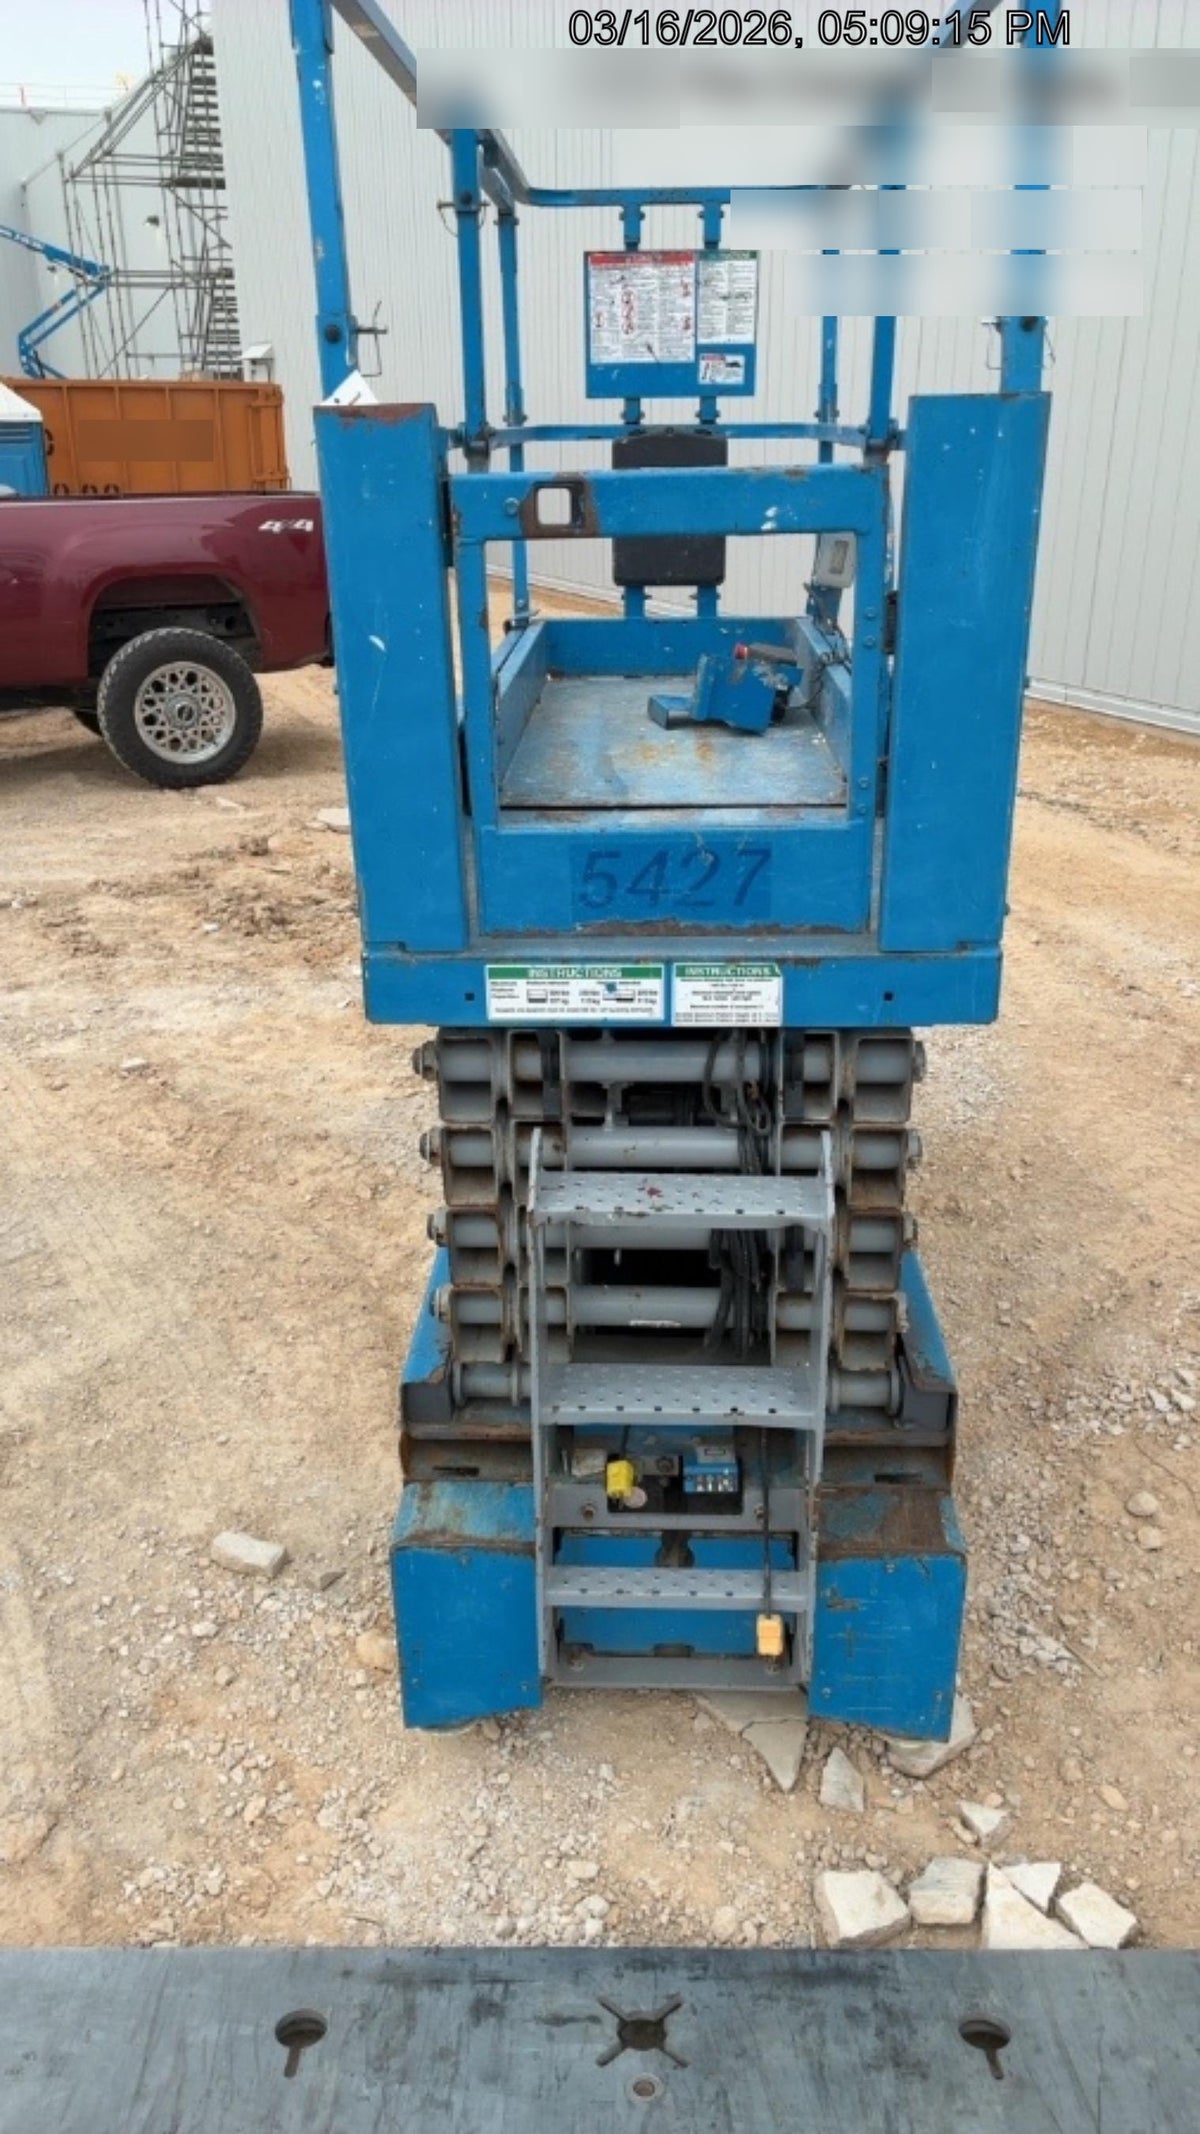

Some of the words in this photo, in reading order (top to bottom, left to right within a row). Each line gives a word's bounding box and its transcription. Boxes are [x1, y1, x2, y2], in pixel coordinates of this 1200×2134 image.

[579, 848, 772, 908] 5427
[528, 967, 623, 979] INSTRUCTIONS
[684, 966, 771, 977] INSTRUCTIONS
